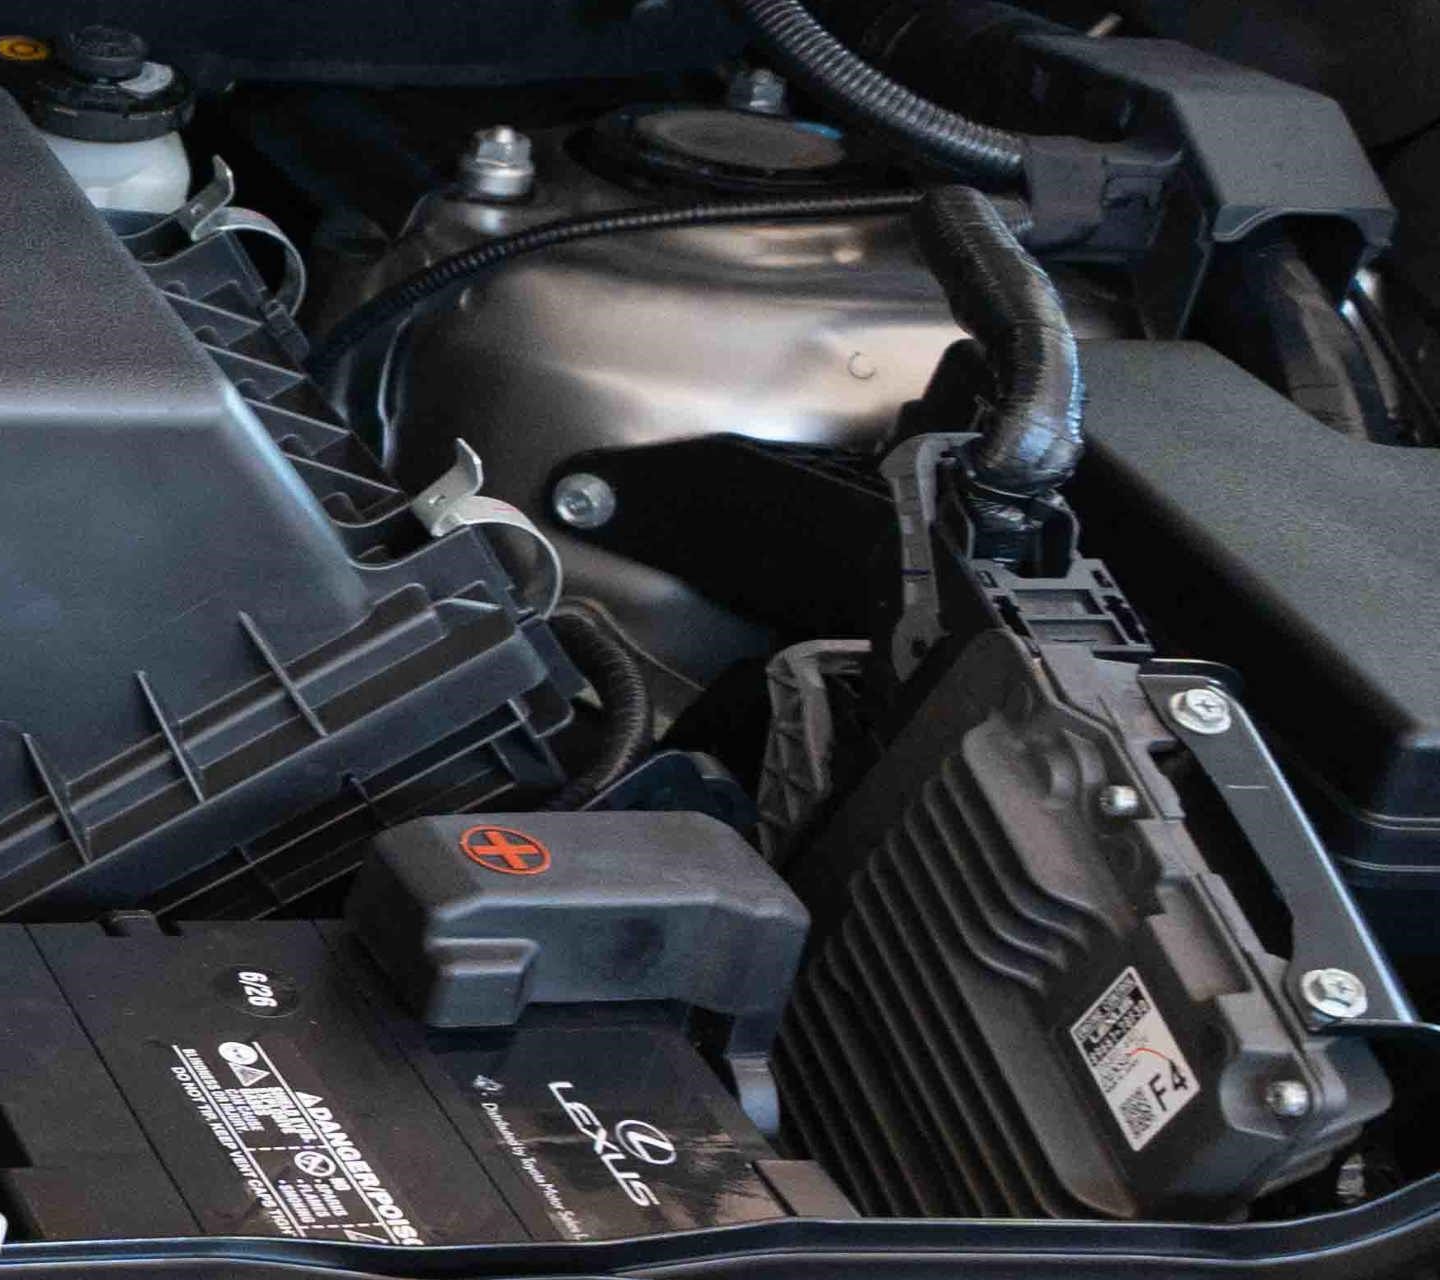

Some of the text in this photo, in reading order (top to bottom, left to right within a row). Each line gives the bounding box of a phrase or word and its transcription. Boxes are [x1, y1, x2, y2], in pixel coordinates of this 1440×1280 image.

[238, 971, 279, 1007] 6/26
[181, 1048, 222, 1089] BLINDNESS
[210, 1090, 230, 1101] OR
[1148, 1058, 1189, 1112] F4
[223, 1089, 265, 1131] CAN CAUSE
[250, 1087, 300, 1134] EXPLOSIVE
[170, 1066, 192, 1081] DO
[181, 1082, 207, 1102] NOT
[208, 1122, 239, 1149] KEEP
[229, 1150, 258, 1177] VENT
[247, 1178, 278, 1207] CAPS
[547, 1081, 661, 1207] LEXUS
[278, 1184, 316, 1222] SMOKING
[295, 1183, 332, 1216] FLAMES
[314, 1183, 349, 1215] SPARKS
[520, 1157, 547, 1184] Toyota
[537, 1183, 566, 1211] Motor
